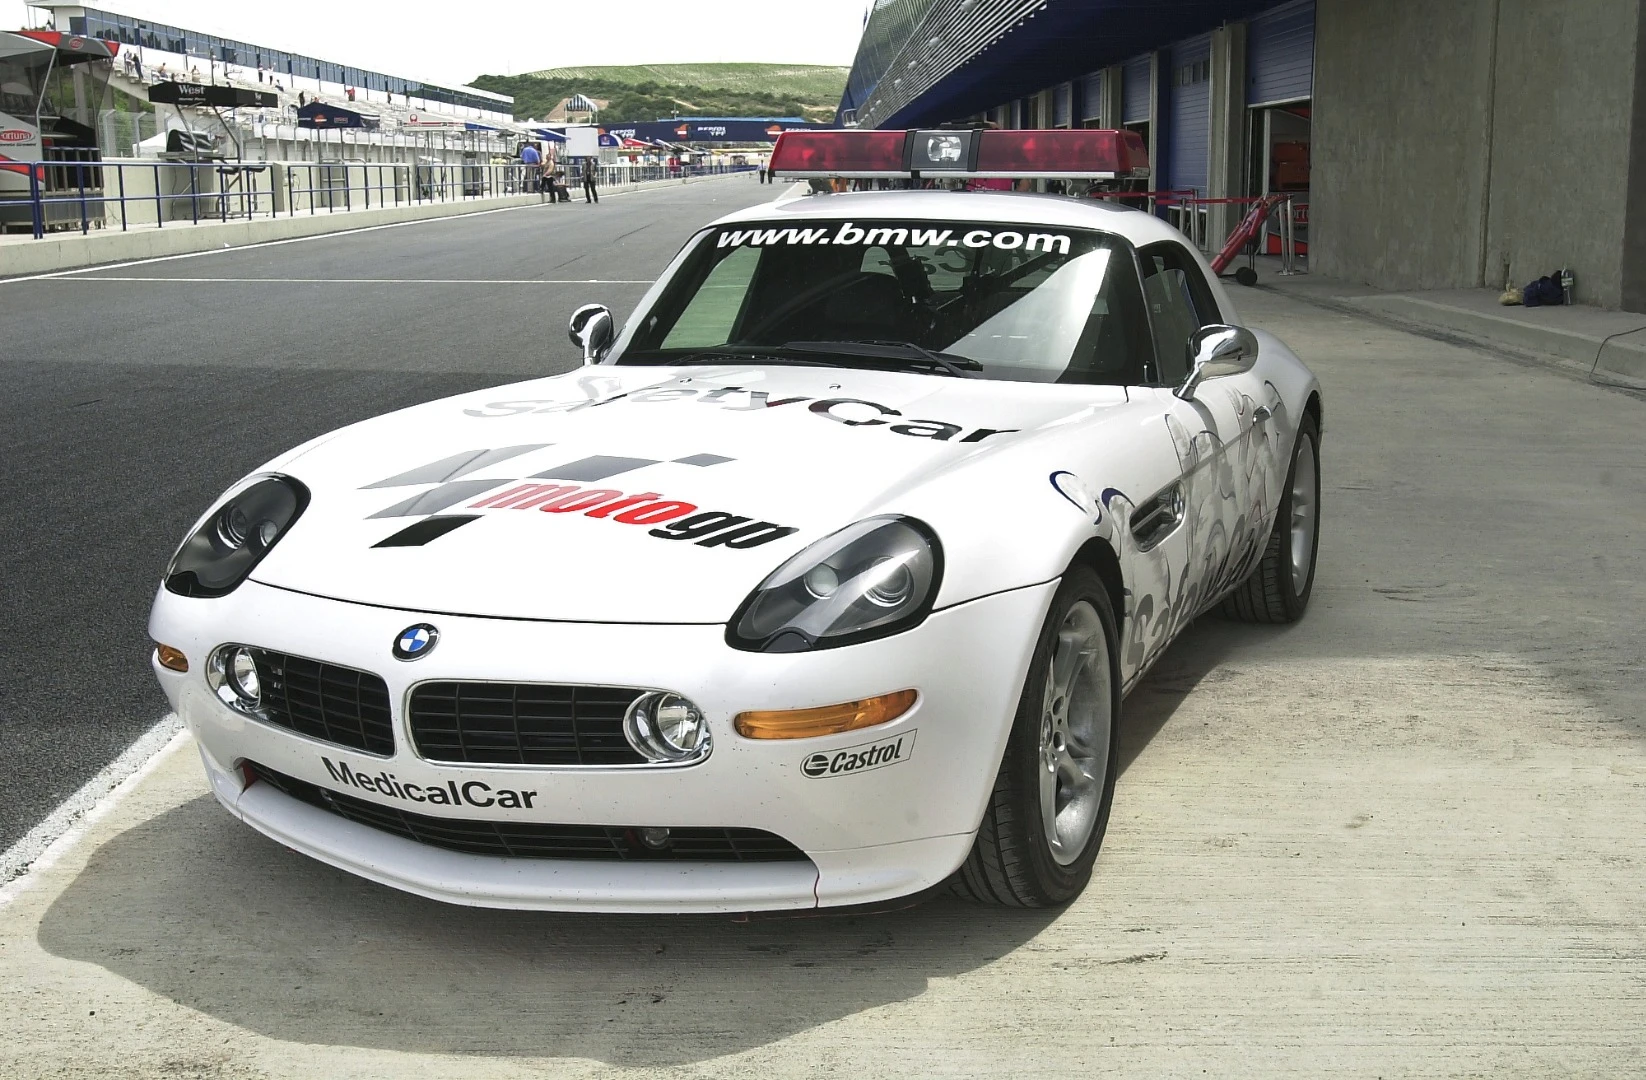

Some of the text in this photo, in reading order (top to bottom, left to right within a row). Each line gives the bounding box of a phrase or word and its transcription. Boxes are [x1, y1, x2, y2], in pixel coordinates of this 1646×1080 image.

[178, 84, 206, 95] West
[0, 131, 30, 140] ortuna
[716, 222, 1071, 255] www.bmw.com
[465, 483, 800, 549] motogp
[829, 738, 903, 774] Castrol
[321, 757, 538, 809] MedicalCar
